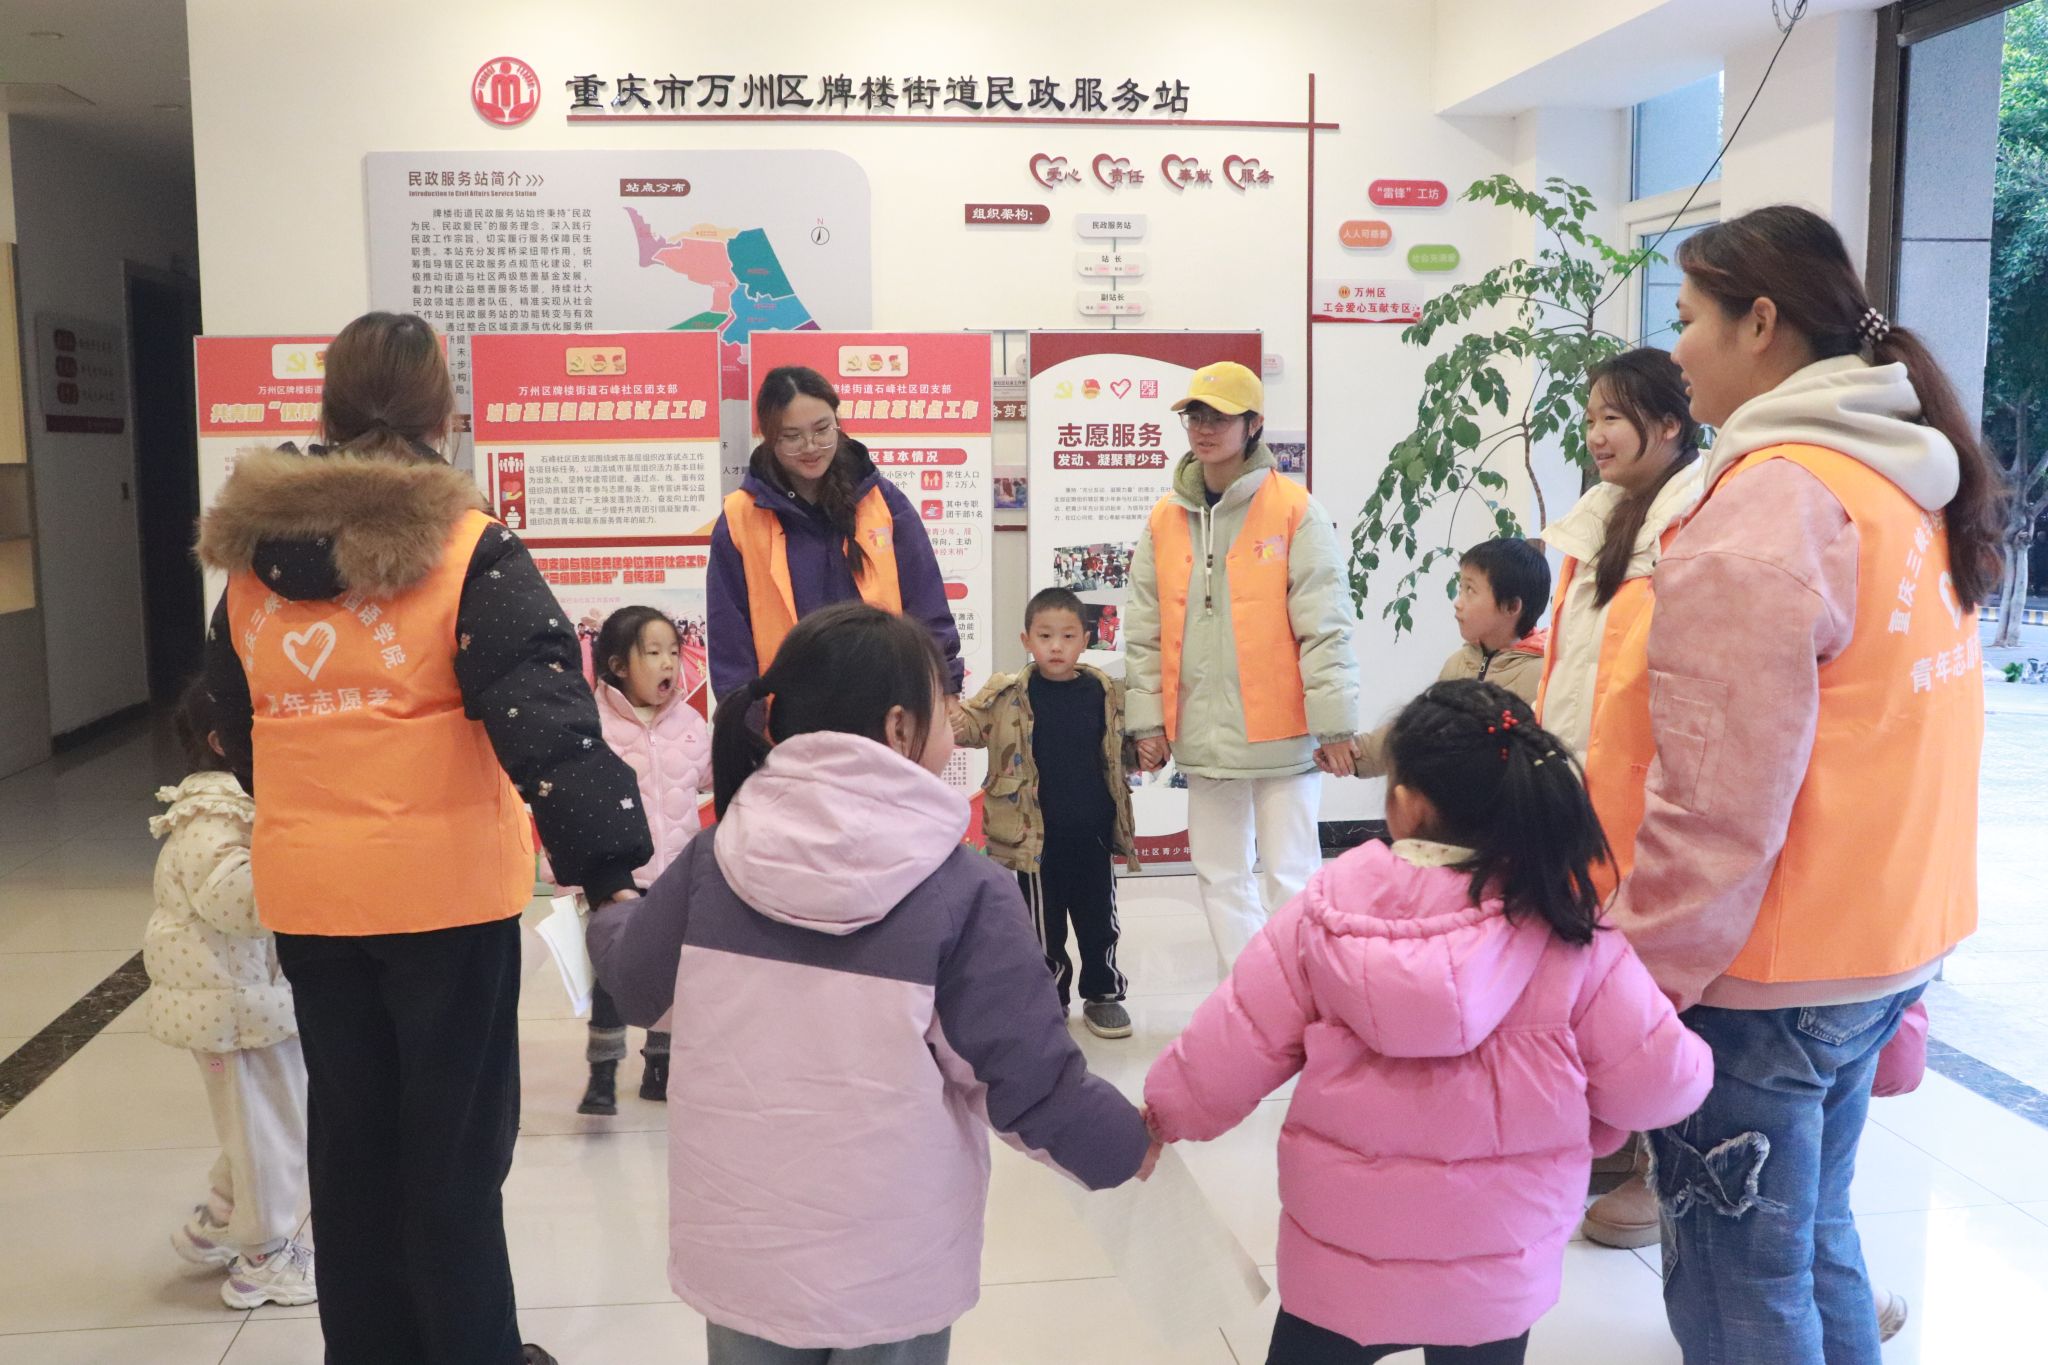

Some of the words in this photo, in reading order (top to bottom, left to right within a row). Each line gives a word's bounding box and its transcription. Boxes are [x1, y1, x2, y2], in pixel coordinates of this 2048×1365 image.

[565, 73, 1190, 113] 重庆市万州区牌楼街道民政服务站
[408, 171, 521, 186] 民政服务站简介
[1046, 168, 1082, 183] 爱心
[1109, 168, 1144, 184] 责任
[1178, 168, 1213, 184] 奉献
[1238, 168, 1275, 184] 服务
[626, 183, 686, 193] 站点分布
[1092, 221, 1132, 230] 民政服务站
[1354, 288, 1386, 298] 万州区
[518, 384, 678, 396] 万州区牌楼街道石峰社区团支部
[486, 400, 706, 422] 城市基层组织改革试点工作
[1058, 422, 1162, 448] 志愿服务
[1058, 454, 1163, 466] 发动、凝聚青少年
[946, 470, 980, 478] 常住人口
[946, 500, 978, 508] 其中专职
